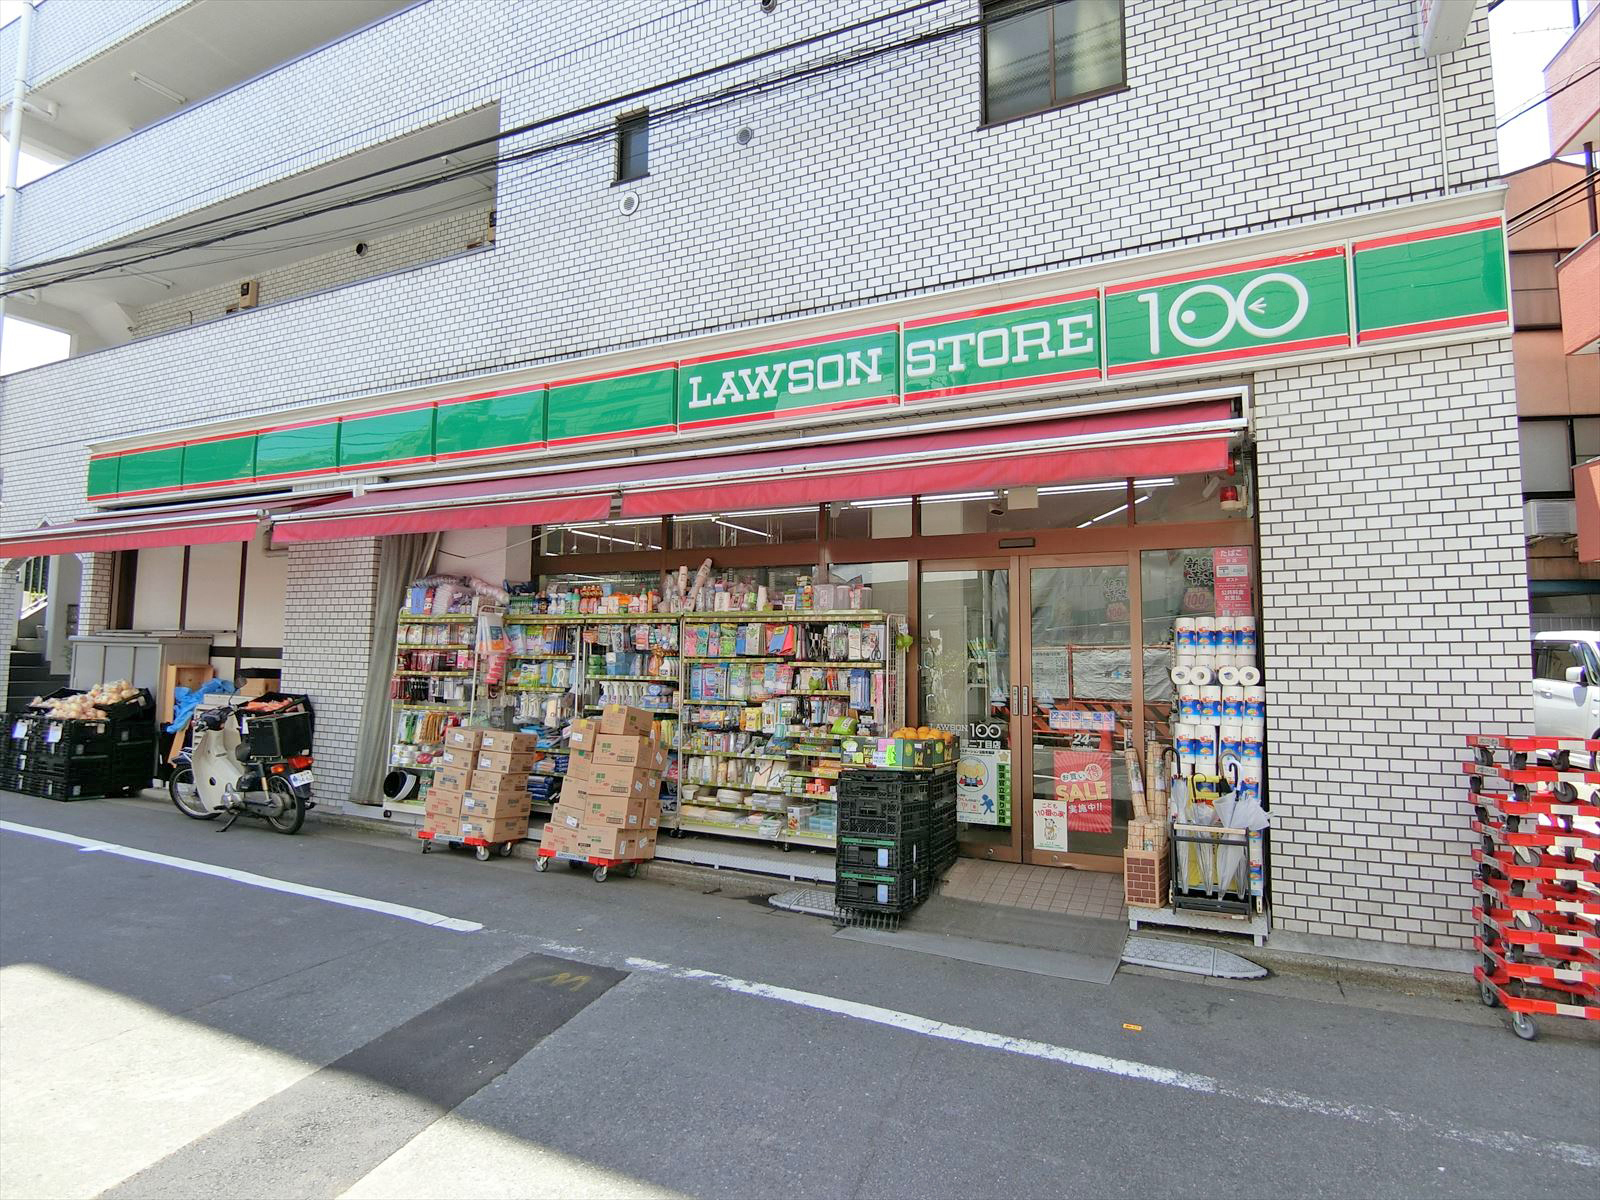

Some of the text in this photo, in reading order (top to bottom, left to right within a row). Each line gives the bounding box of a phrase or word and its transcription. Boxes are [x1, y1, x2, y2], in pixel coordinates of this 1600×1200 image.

[688, 272, 1309, 409] LAWSON STORE 100
[969, 723, 1001, 738] 100
[1055, 780, 1109, 803] SALE
